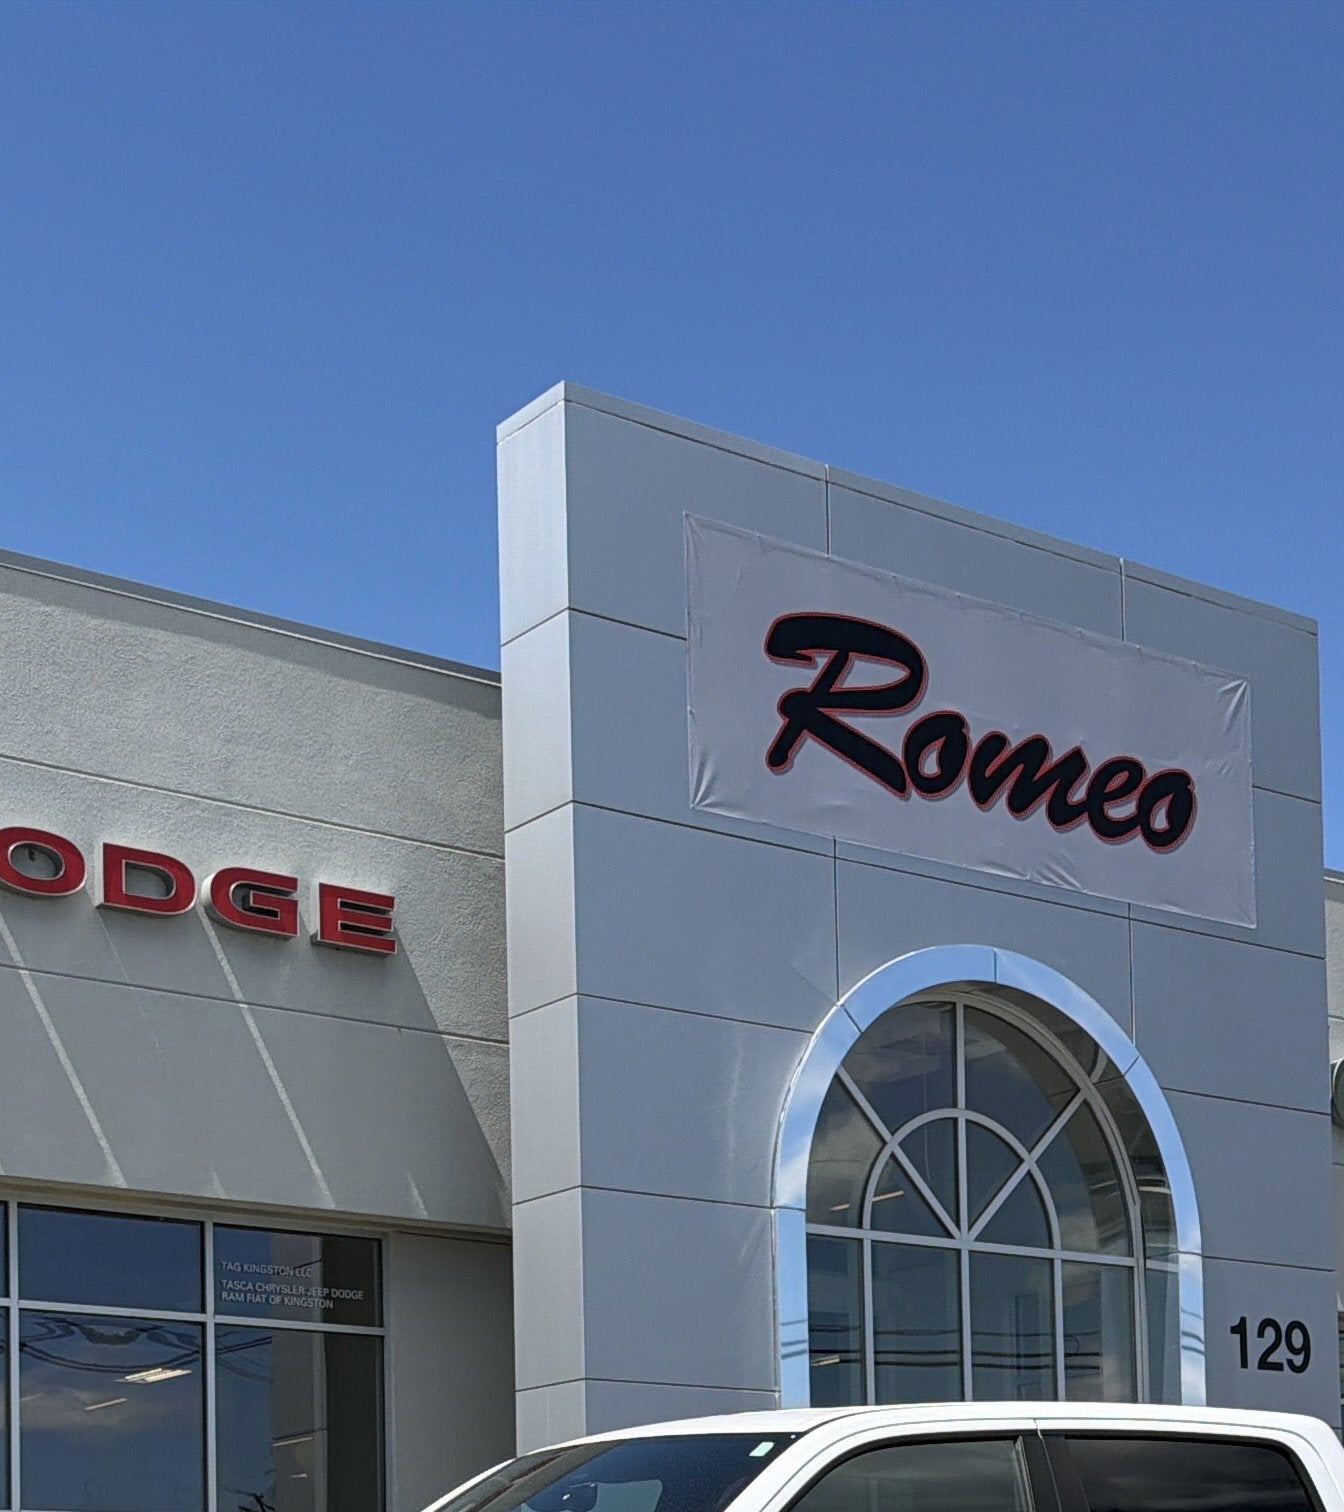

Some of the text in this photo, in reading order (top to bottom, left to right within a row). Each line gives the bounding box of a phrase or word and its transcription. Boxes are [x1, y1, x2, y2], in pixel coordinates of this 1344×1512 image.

[764, 611, 1197, 854] Romeo
[220, 1260, 314, 1278] TAG KINGSTON LLC
[220, 1279, 365, 1300] TASCA CHRYSLER JEEP DODGE
[221, 1291, 334, 1310] RAM FIAT OF KINGSTON
[1229, 1316, 1312, 1374] 129
